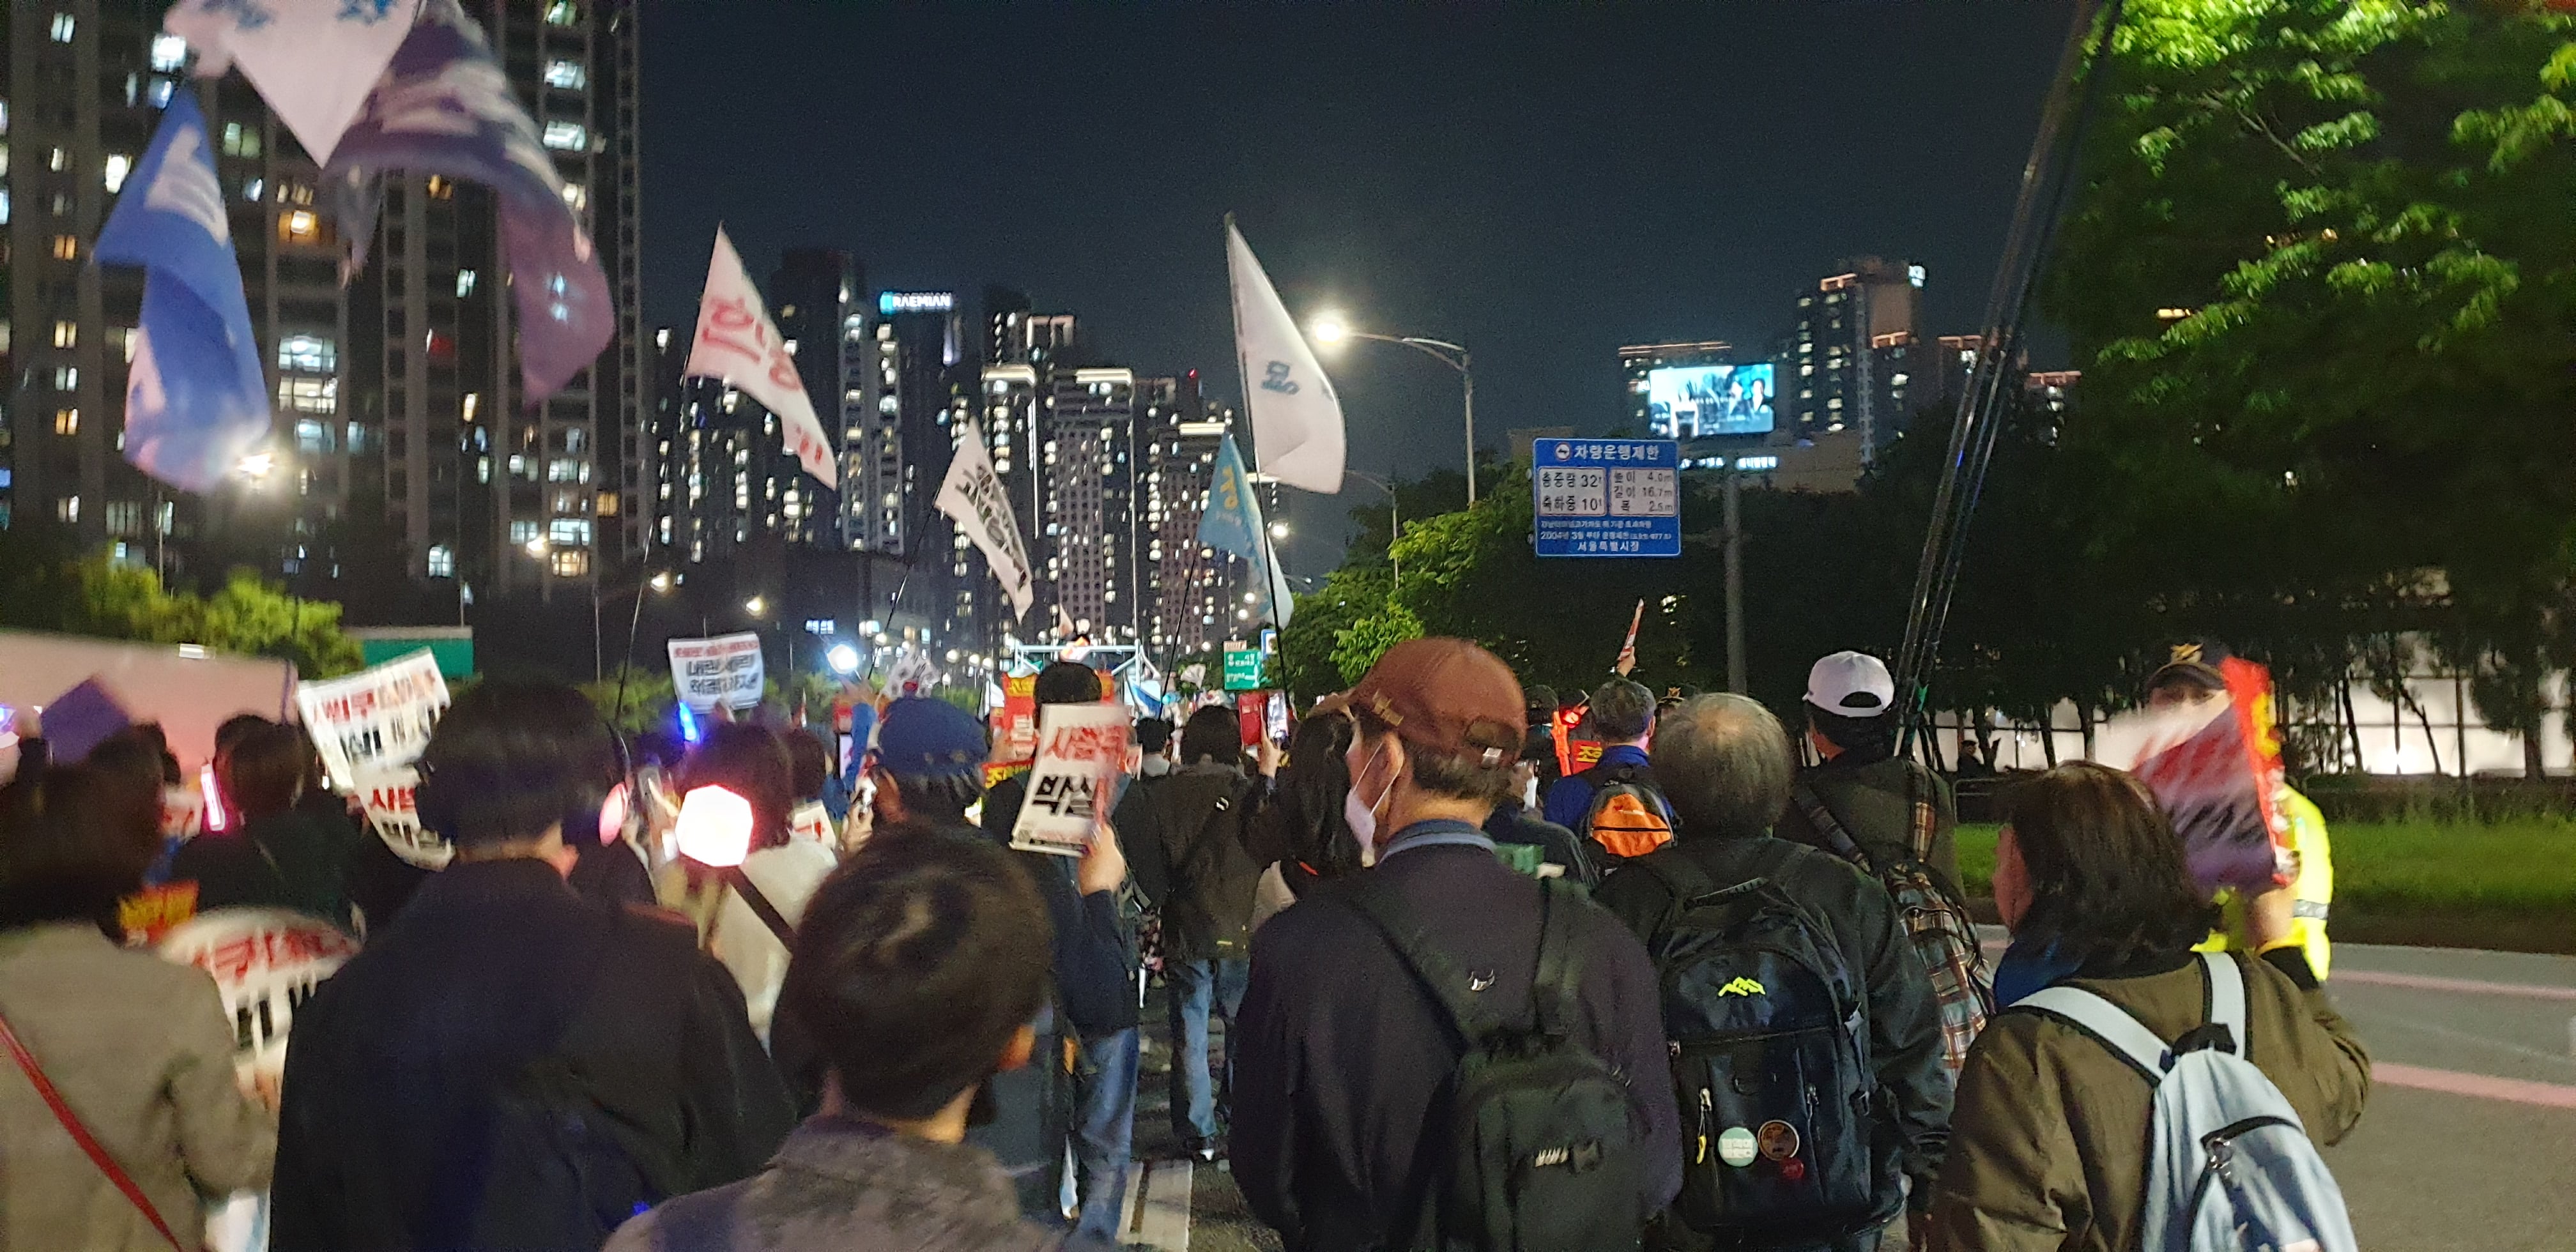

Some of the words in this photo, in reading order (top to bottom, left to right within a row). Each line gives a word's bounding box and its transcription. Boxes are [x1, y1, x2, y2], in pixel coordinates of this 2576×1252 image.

[893, 293, 951, 308] RAEMIAN
[1574, 444, 1659, 460] 차량운행제한
[1542, 471, 1575, 487] 총중량
[1614, 471, 1636, 484] 높이
[1614, 485, 1636, 499] 길이
[1542, 495, 1575, 511] 축하중
[1577, 541, 1639, 552] 서울특별시장
